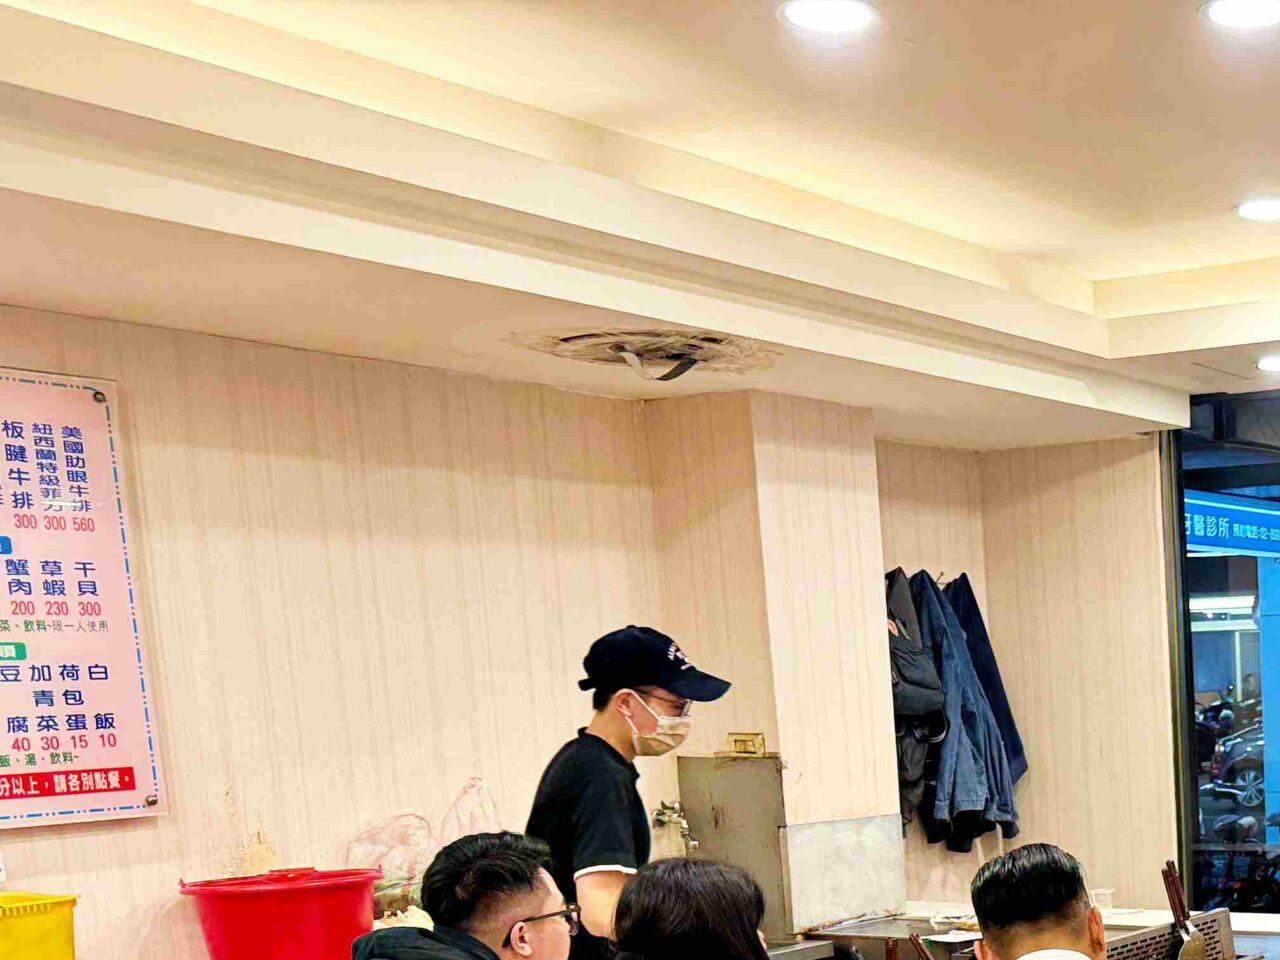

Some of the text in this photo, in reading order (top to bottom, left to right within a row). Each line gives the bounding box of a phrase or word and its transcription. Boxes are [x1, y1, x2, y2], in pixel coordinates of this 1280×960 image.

[2, 420, 34, 509] 板腱牛排
[14, 513, 95, 532] 300 300 560
[5, 559, 32, 595] 蟹肉
[40, 560, 66, 596] 草蝦
[74, 561, 99, 597] 干貝
[11, 600, 101, 616] 200 230 300
[12, 733, 117, 752] 40 30 15 10
